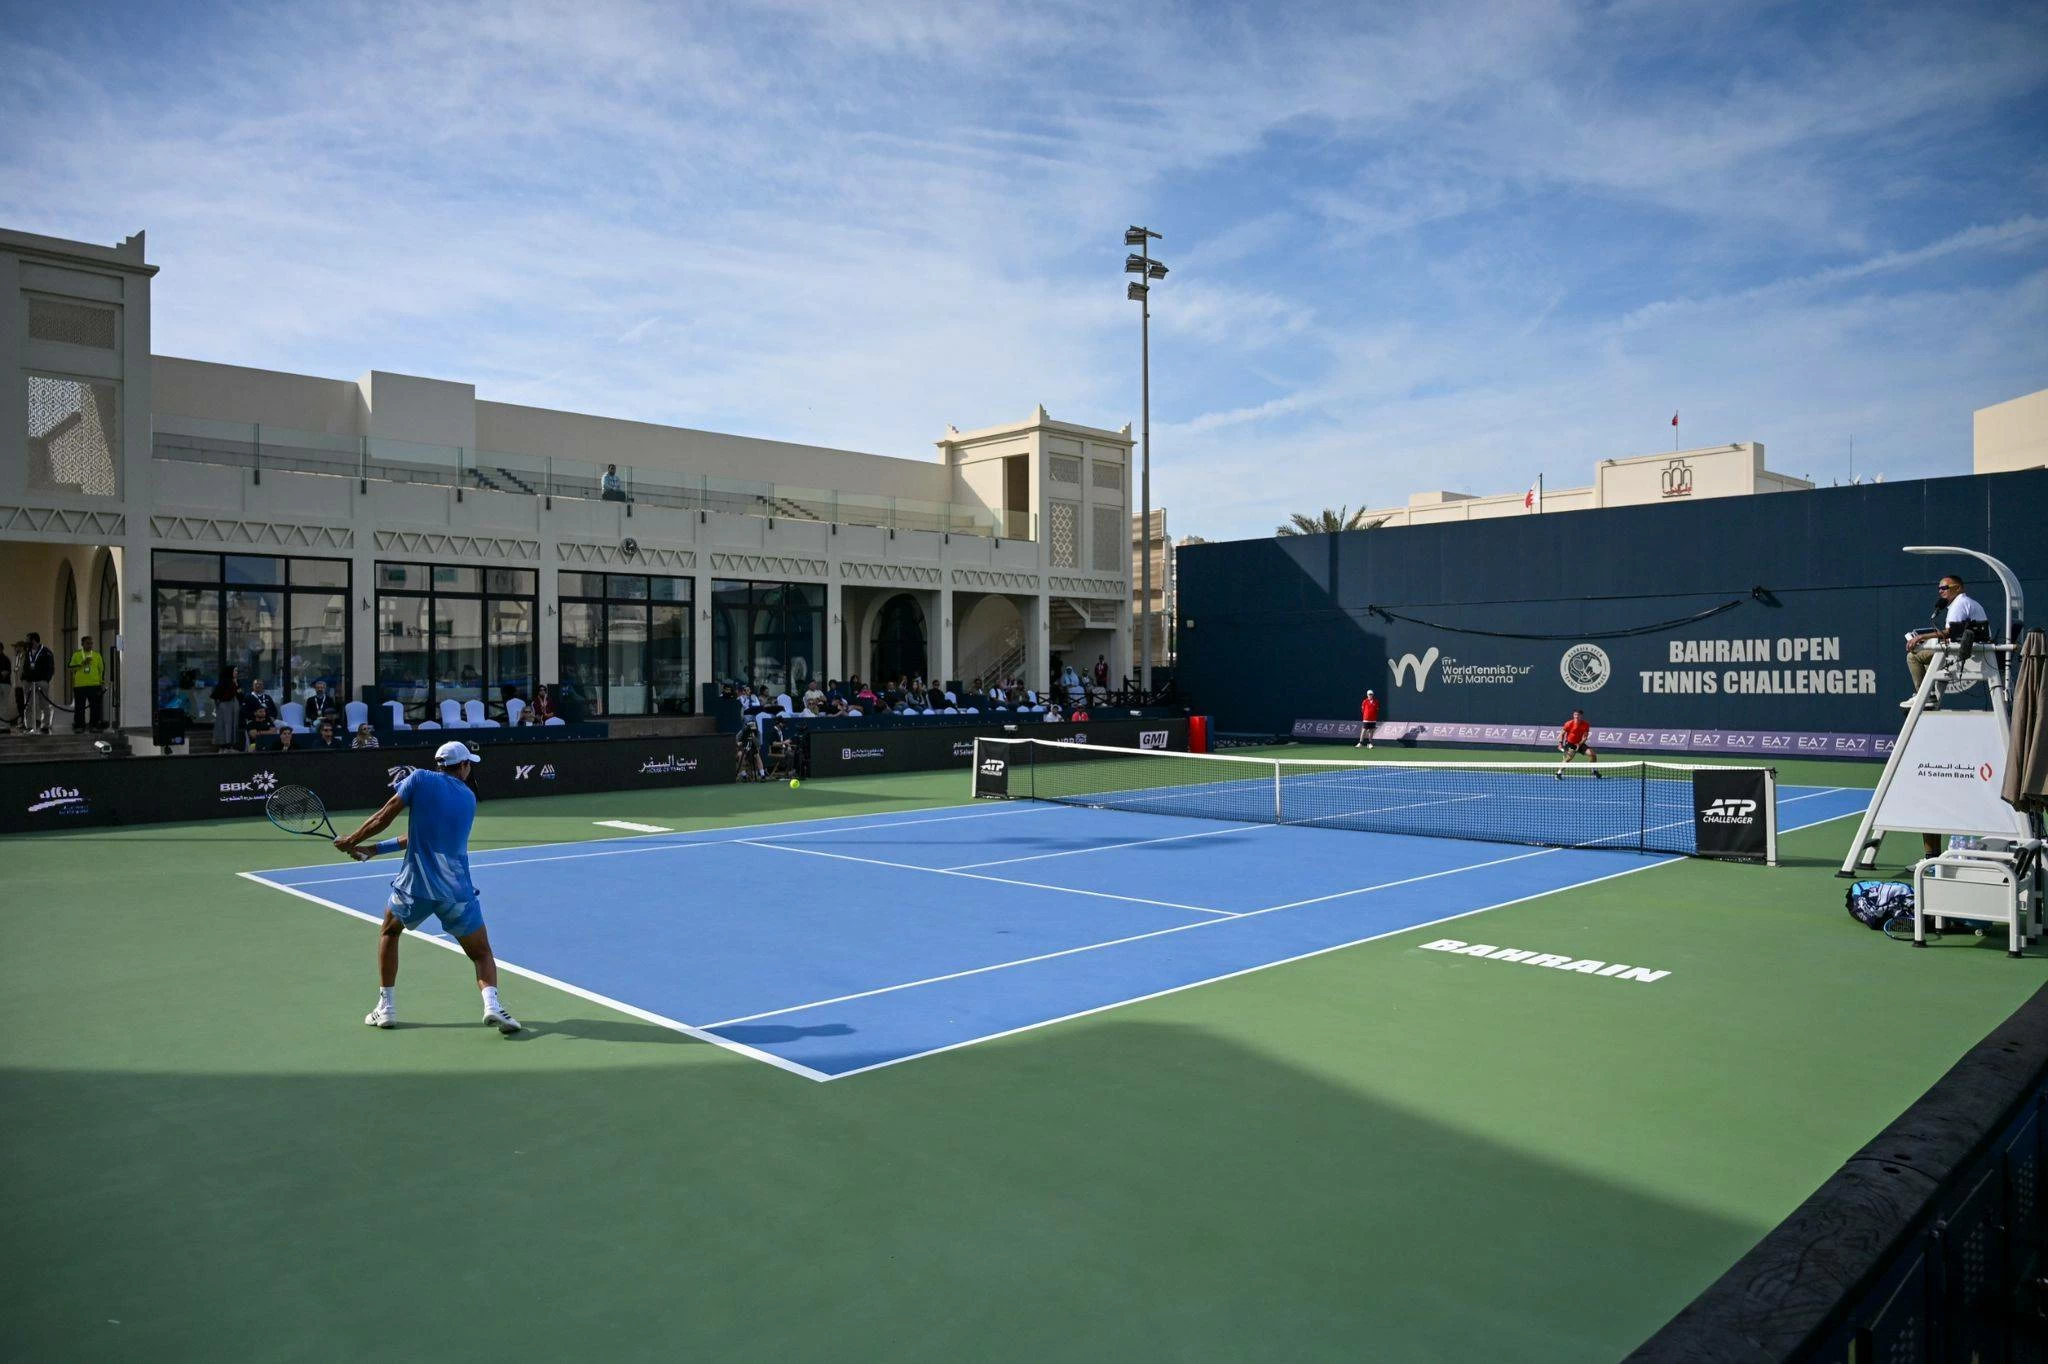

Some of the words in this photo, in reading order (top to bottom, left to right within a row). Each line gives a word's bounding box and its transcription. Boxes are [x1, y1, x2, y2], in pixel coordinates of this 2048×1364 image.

[1670, 640, 1770, 662] BAHRAIN
[1777, 637, 1840, 661] OPEN
[1442, 675, 1463, 684] W75
[1465, 675, 1513, 684] Manama
[1639, 671, 1717, 694] TENNIS
[1723, 669, 1876, 694] CHALLENGER
[1142, 732, 1166, 745] GMI
[1458, 727, 1481, 736] EA7
[1485, 728, 1508, 737] EA7
[1512, 729, 1535, 737] EA7
[1597, 732, 1623, 741] EA7
[1628, 733, 1654, 742] EA7
[1660, 734, 1687, 743] EA7
[1693, 734, 1720, 744] EA7
[1727, 735, 1755, 745] EA7
[1762, 736, 1791, 746] EA7
[1798, 737, 1828, 747] EA7
[1835, 738, 1866, 748] EA7
[1875, 740, 1895, 750] EA
[981, 758, 1005, 771] ATP
[1927, 770, 1953, 778] Salam
[219, 782, 253, 792] BBK
[1700, 799, 1757, 816] ATP
[1702, 816, 1753, 824] CHALLENGER
[1417, 938, 1672, 983] BAHRAIN
